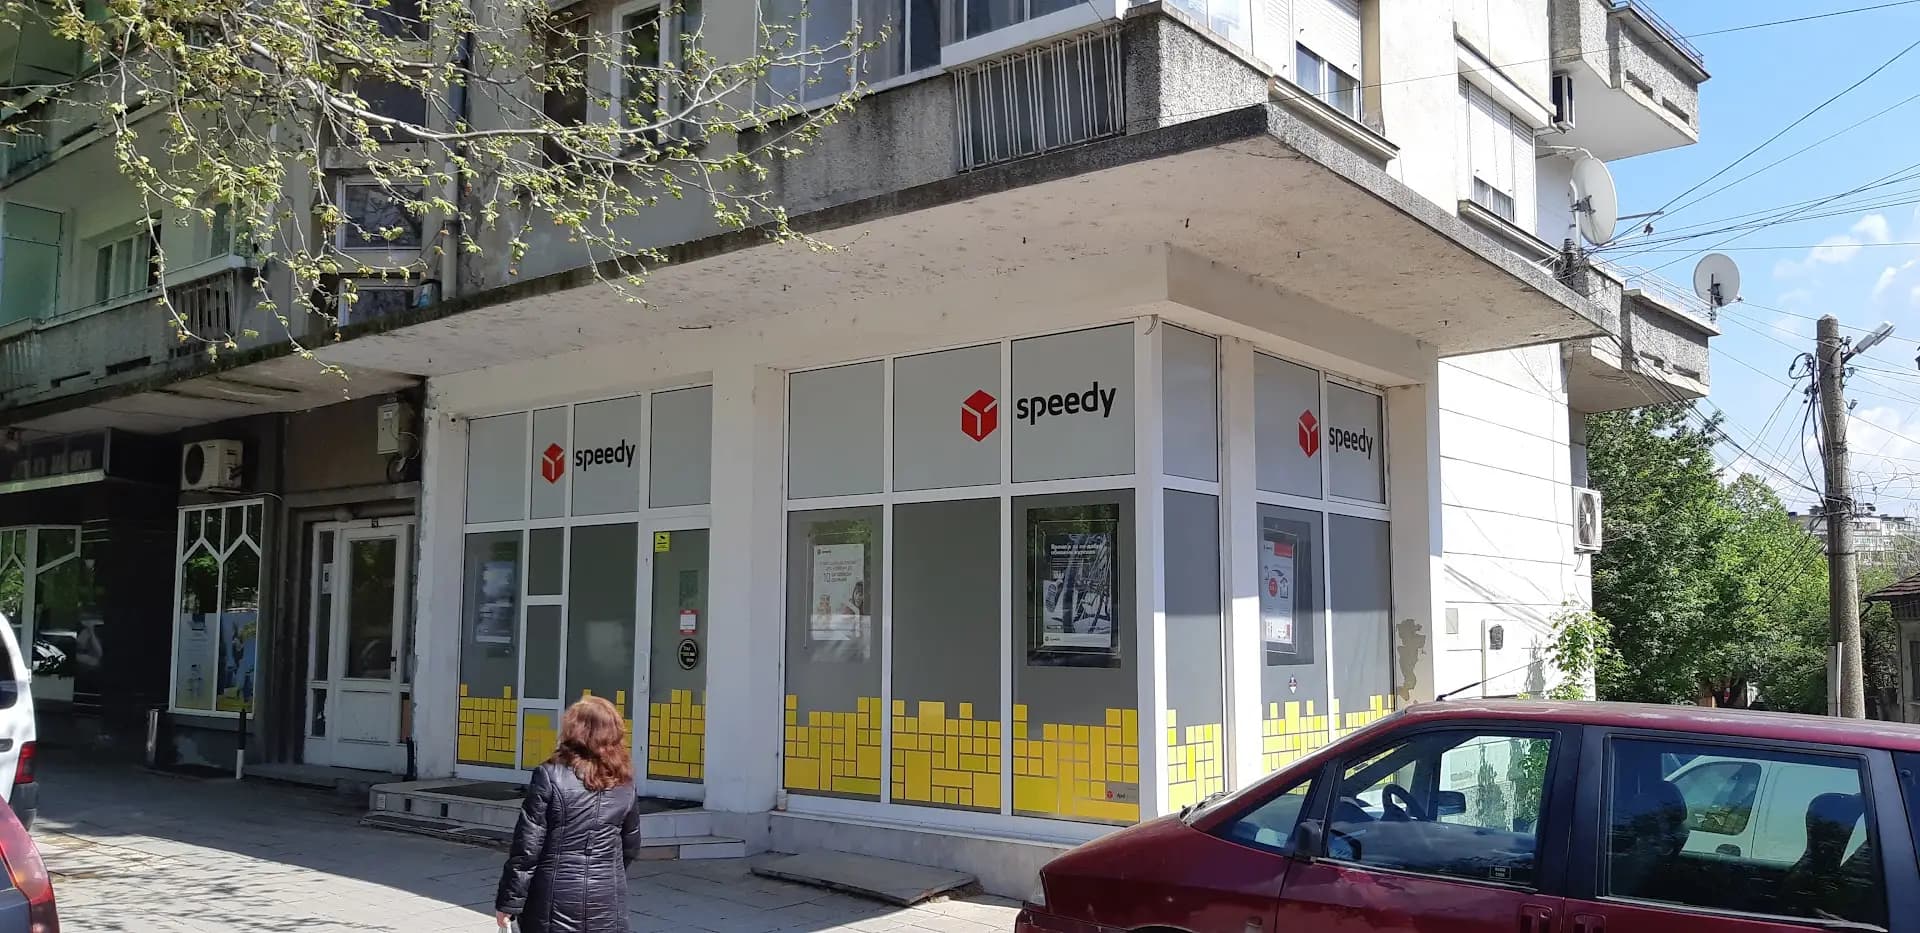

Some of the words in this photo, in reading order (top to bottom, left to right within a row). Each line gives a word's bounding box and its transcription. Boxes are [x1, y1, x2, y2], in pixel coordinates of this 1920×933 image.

[1016, 381, 1116, 426] speedy
[575, 438, 635, 472] speedy
[1328, 427, 1374, 460] speedy
